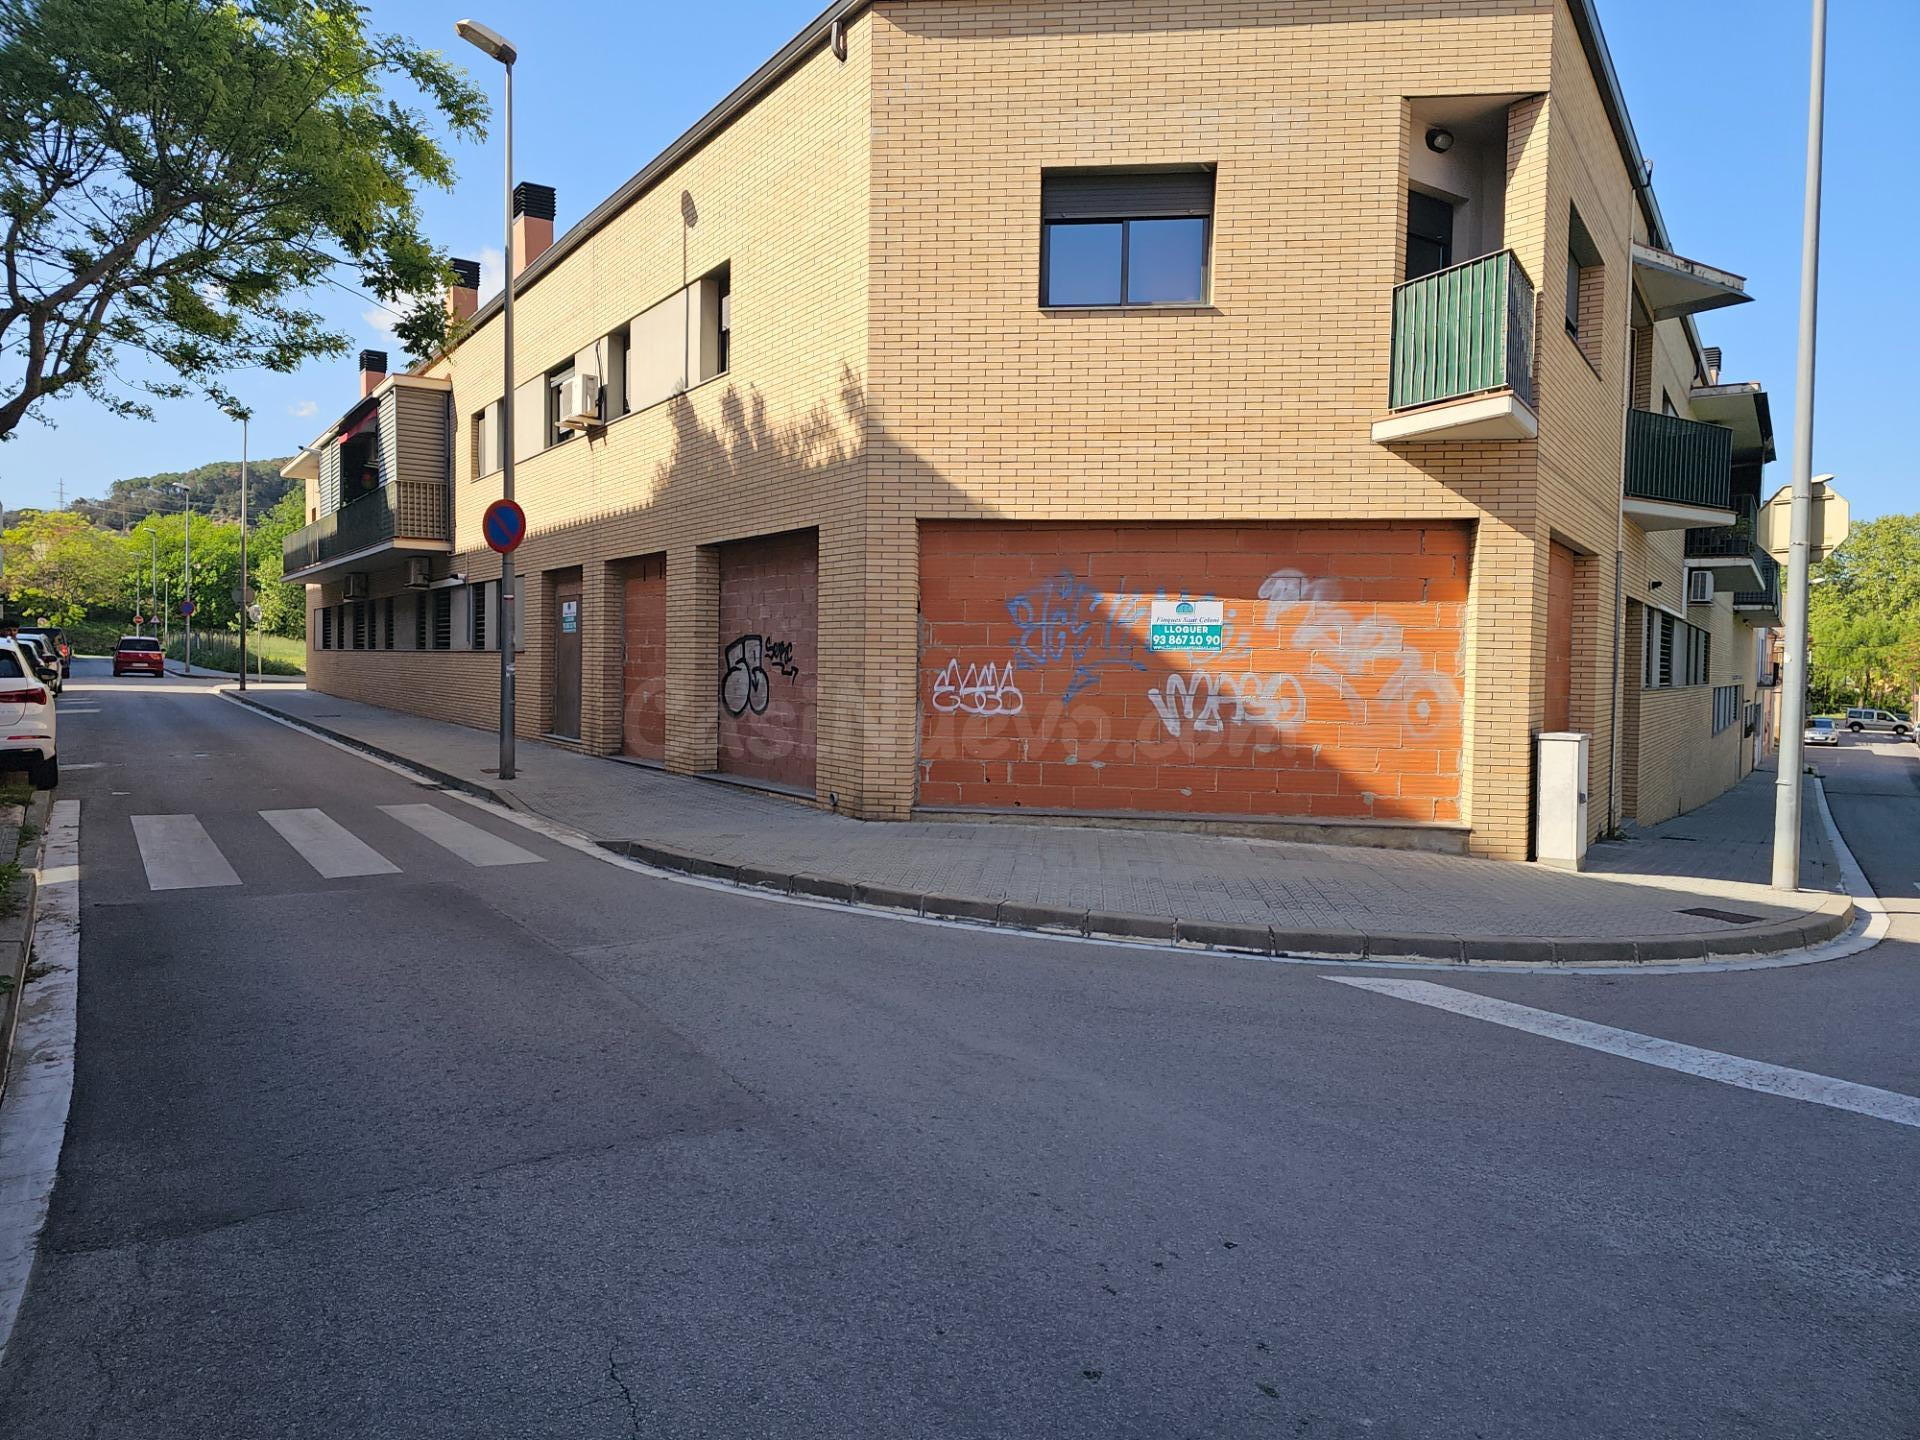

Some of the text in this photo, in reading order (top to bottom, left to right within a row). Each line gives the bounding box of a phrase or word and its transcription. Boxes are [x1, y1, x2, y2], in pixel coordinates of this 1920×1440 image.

[1156, 616, 1181, 624] Finques
[1164, 625, 1208, 633] LLOGUER
[1152, 635, 1220, 645] 93 867 10 90
